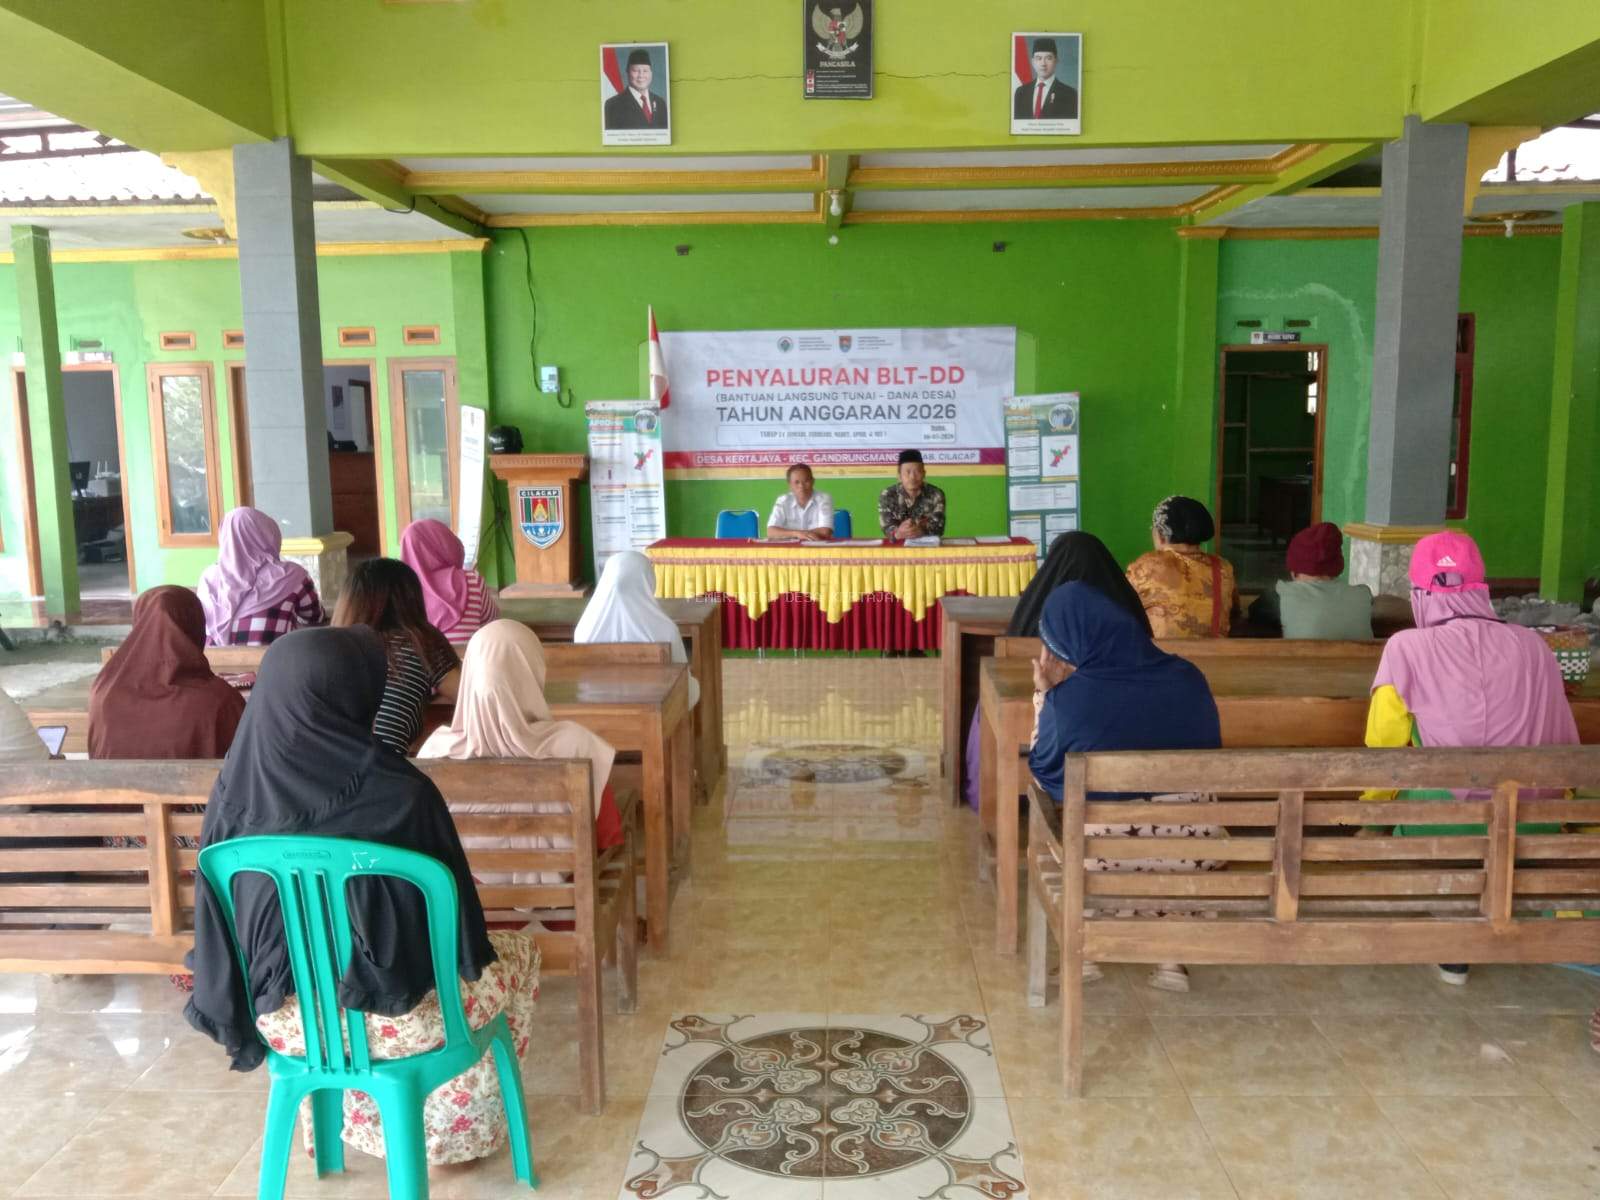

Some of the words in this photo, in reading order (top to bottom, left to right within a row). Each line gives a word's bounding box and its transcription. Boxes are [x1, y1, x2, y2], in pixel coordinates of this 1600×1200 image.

[707, 368, 869, 387] PENYALURAN
[877, 366, 965, 384] BLT-DD
[716, 392, 774, 403] (BANTUAN
[777, 391, 839, 402] LANGSUNG
[842, 391, 876, 401] TUNAI
[887, 391, 919, 401] DANA
[922, 390, 957, 400] DESA)
[716, 406, 783, 422] TAHUN
[789, 405, 901, 421] ANGGARAN
[907, 404, 957, 419] 2026
[697, 455, 723, 465] DESA
[726, 453, 781, 464] KERTAJAYA
[813, 452, 901, 464] GANDRUNGMANG
[938, 451, 976, 461] CILACAP
